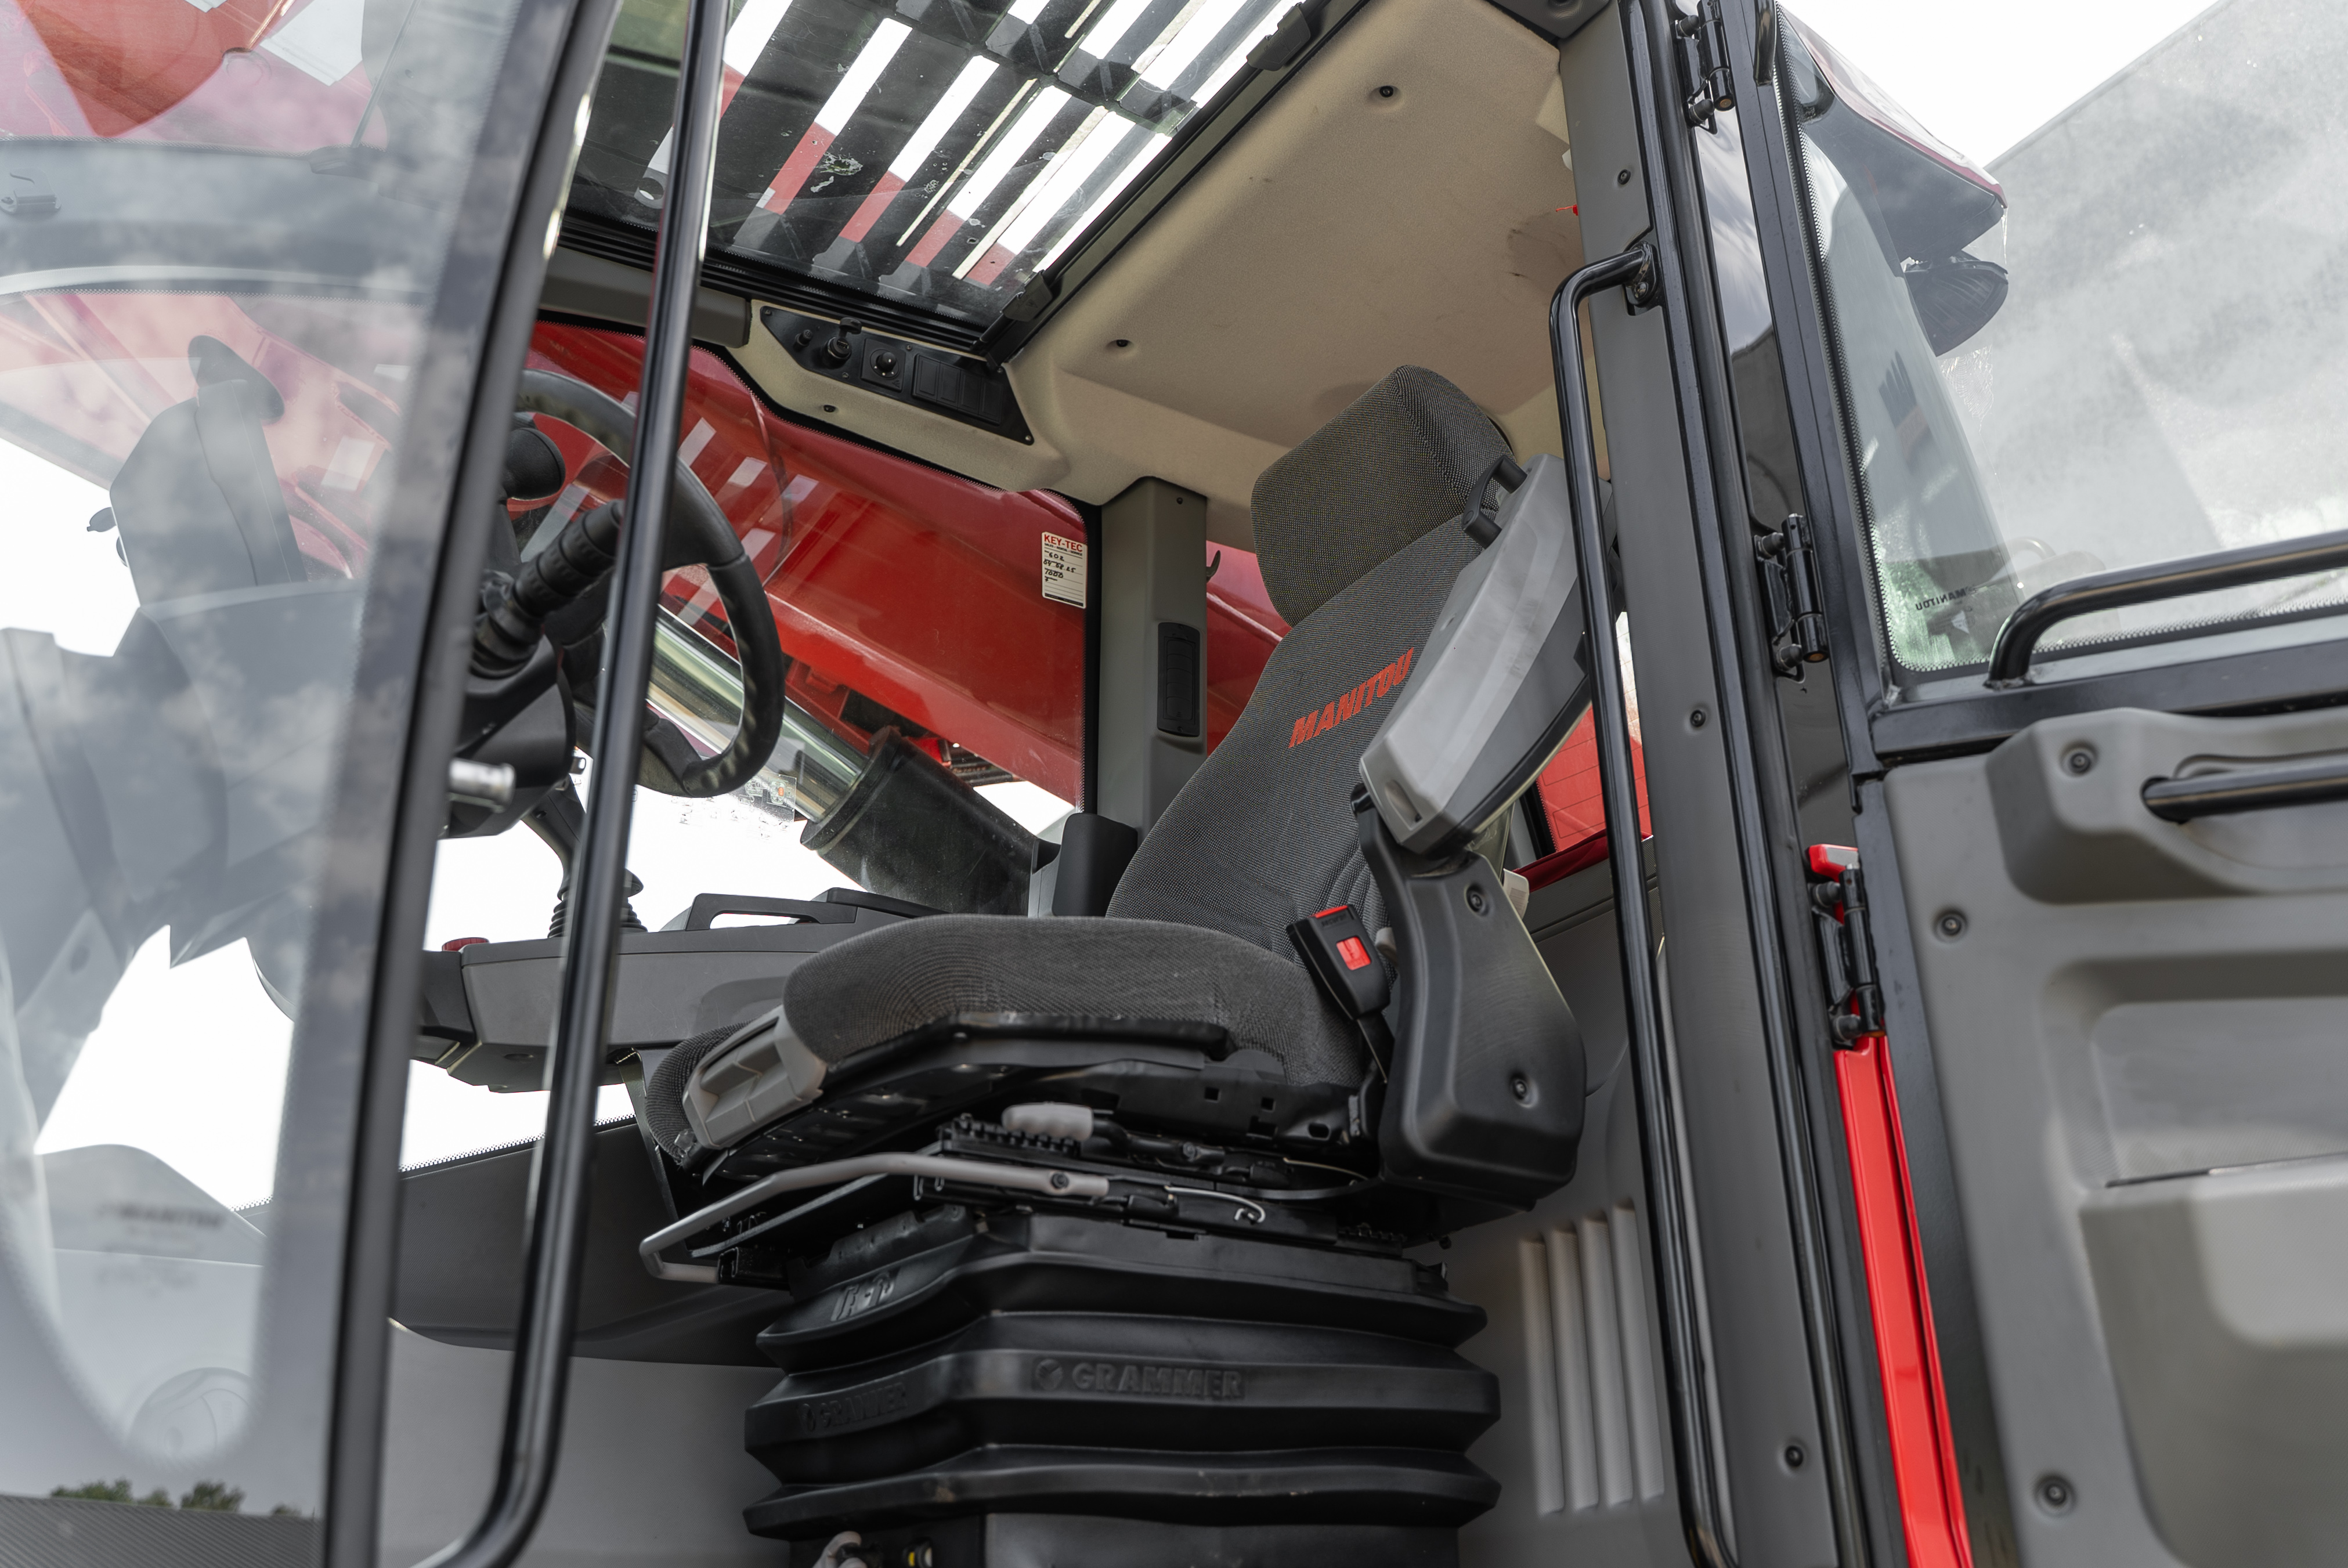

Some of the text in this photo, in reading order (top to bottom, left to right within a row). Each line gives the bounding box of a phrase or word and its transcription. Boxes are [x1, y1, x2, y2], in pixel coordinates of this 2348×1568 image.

[1044, 534, 1083, 552] KEY-TEC
[1288, 646, 1414, 749] MANITOU
[1072, 1361, 1244, 1399] GRAMMER
